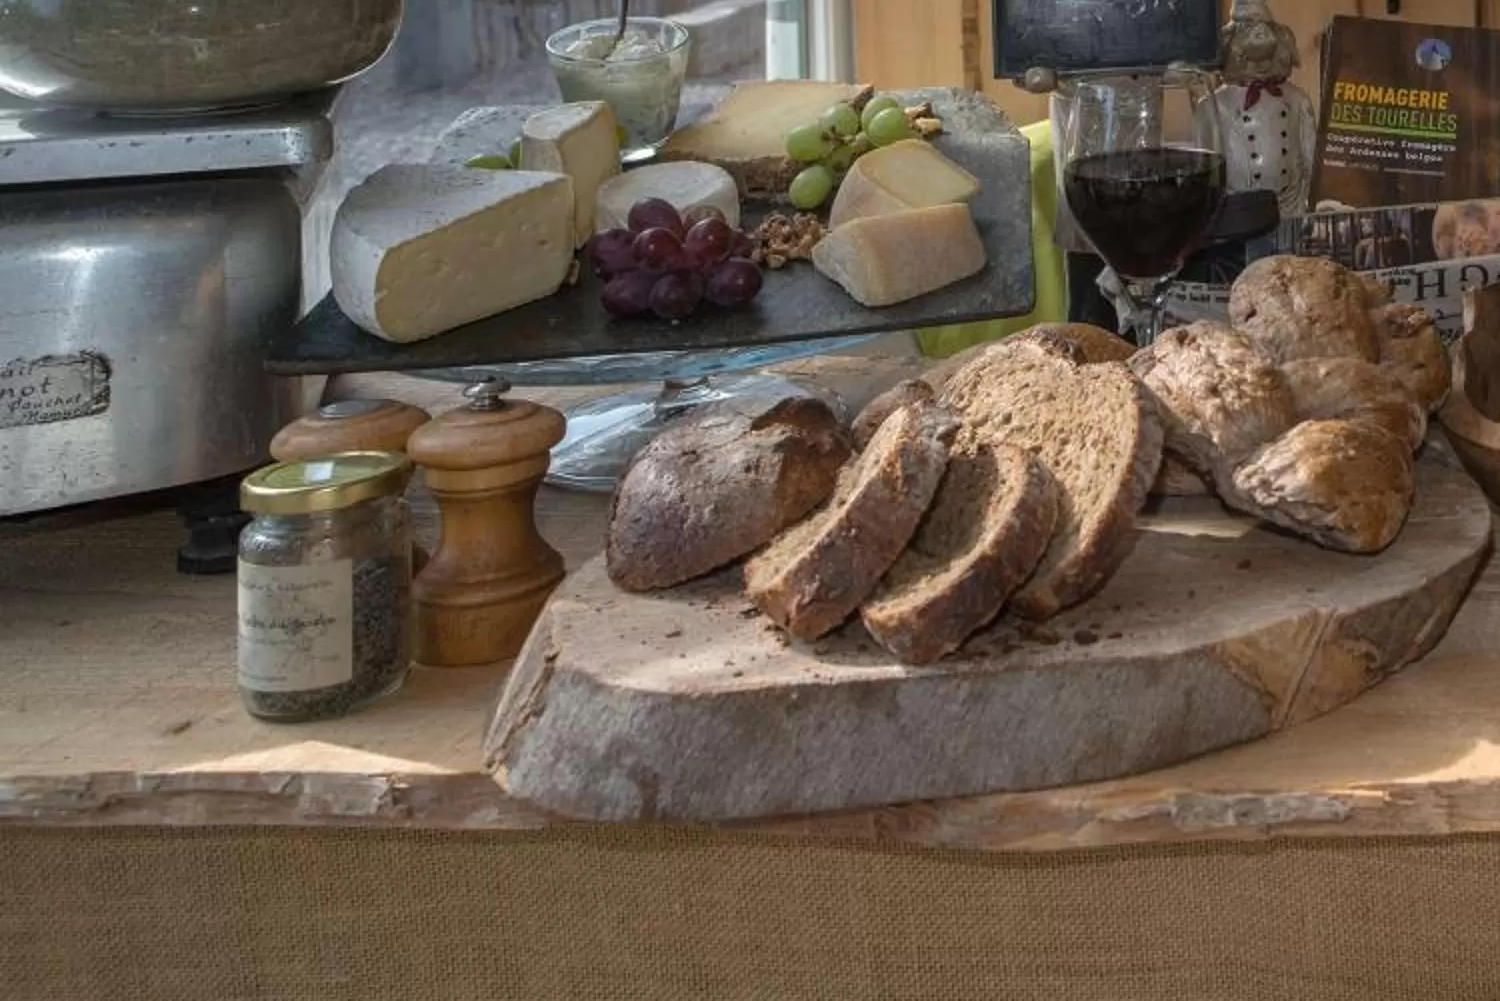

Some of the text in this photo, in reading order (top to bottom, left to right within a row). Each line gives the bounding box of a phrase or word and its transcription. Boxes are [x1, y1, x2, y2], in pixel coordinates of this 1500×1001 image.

[1333, 82, 1449, 110] FROMAGERIE
[1331, 103, 1458, 132] DES TOURELLES
